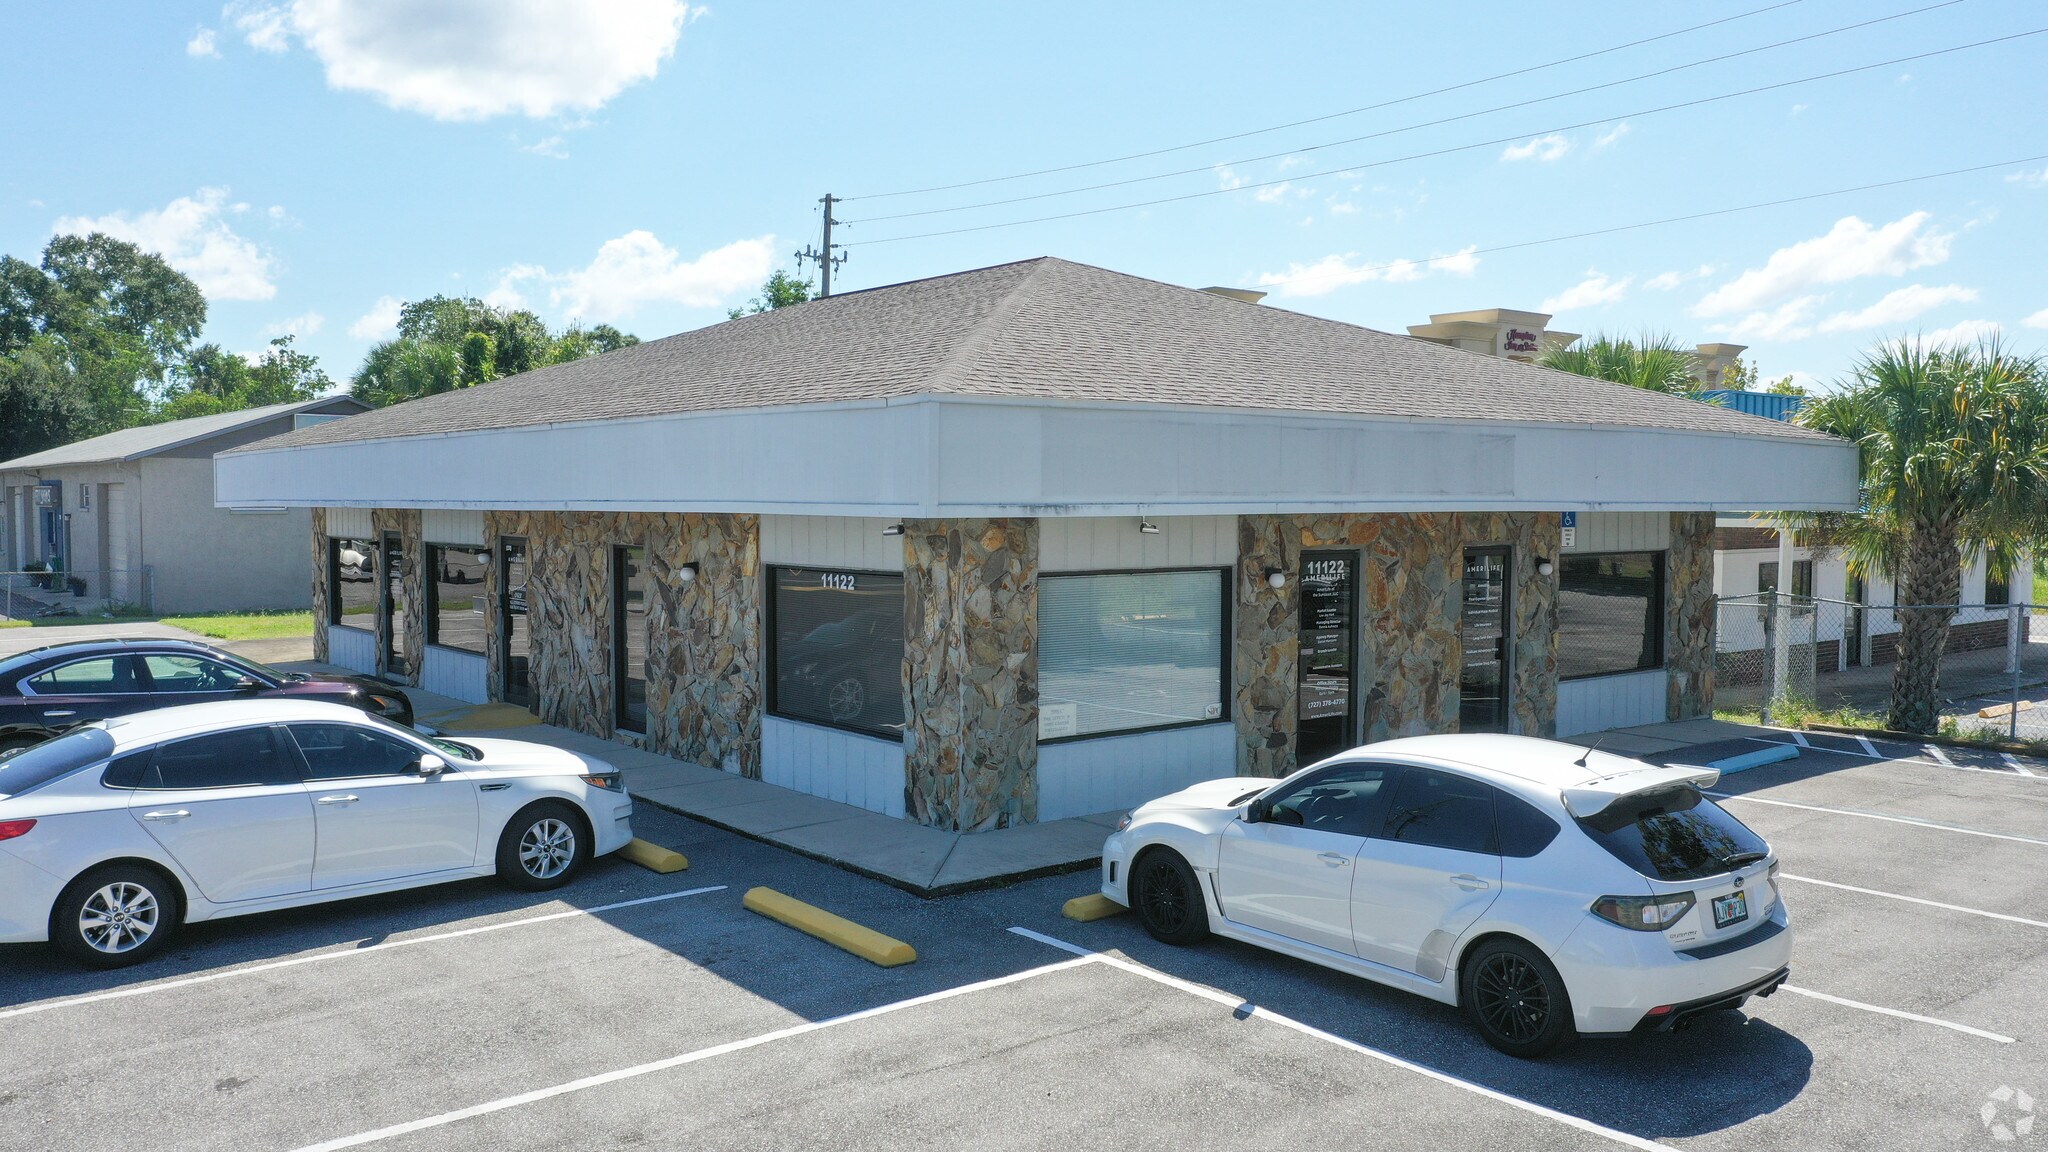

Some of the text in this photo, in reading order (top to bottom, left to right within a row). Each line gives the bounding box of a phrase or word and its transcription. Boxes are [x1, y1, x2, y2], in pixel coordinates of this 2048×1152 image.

[1307, 560, 1345, 574] 11122
[1466, 565, 1500, 573] AMERILIFE
[821, 573, 855, 591] 11122
[1307, 701, 1322, 709] (727)
